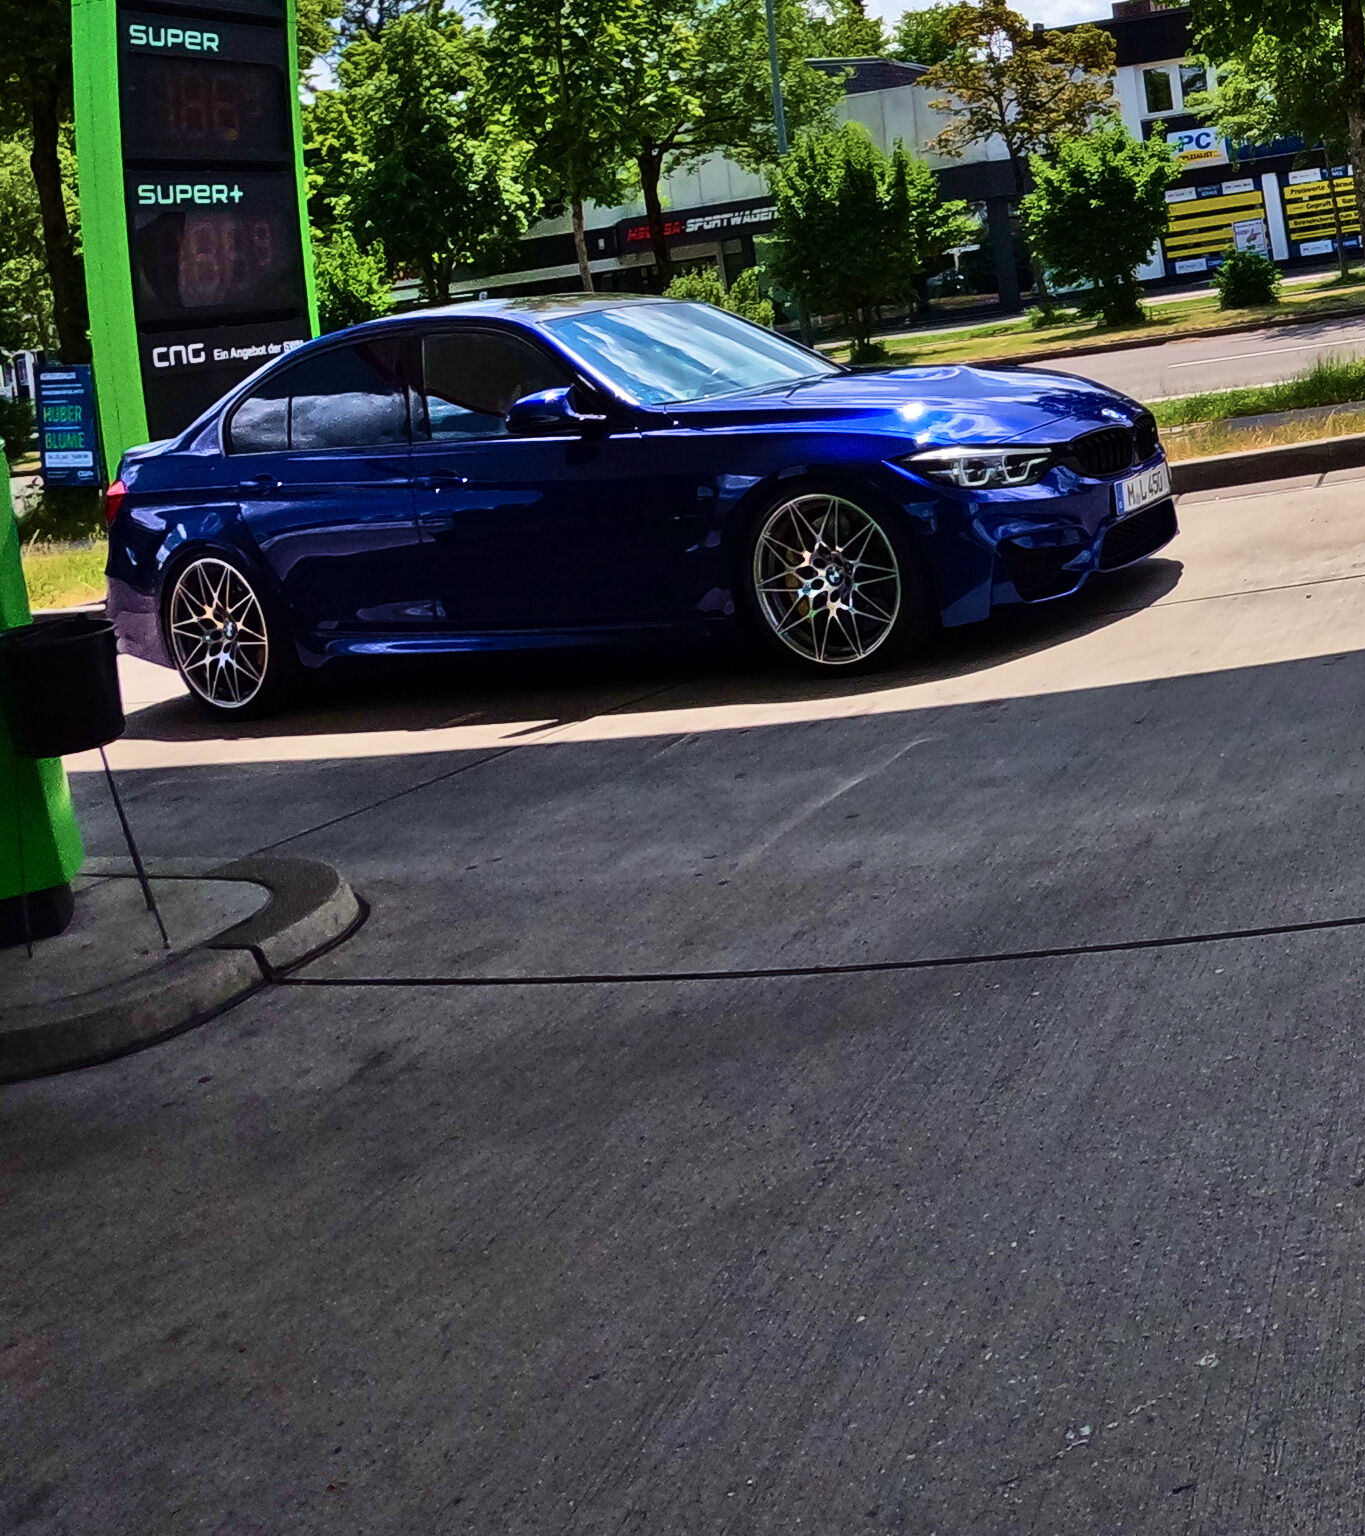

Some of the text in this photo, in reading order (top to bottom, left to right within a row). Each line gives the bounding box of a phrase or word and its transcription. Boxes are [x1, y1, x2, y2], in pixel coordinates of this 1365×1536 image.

[129, 24, 219, 52] SUPER
[1178, 132, 1212, 153] PC
[137, 184, 244, 205] SUPER+
[152, 342, 206, 368] CNG
[213, 349, 229, 361] Ein
[230, 345, 267, 360] Angebot
[267, 343, 282, 355] der
